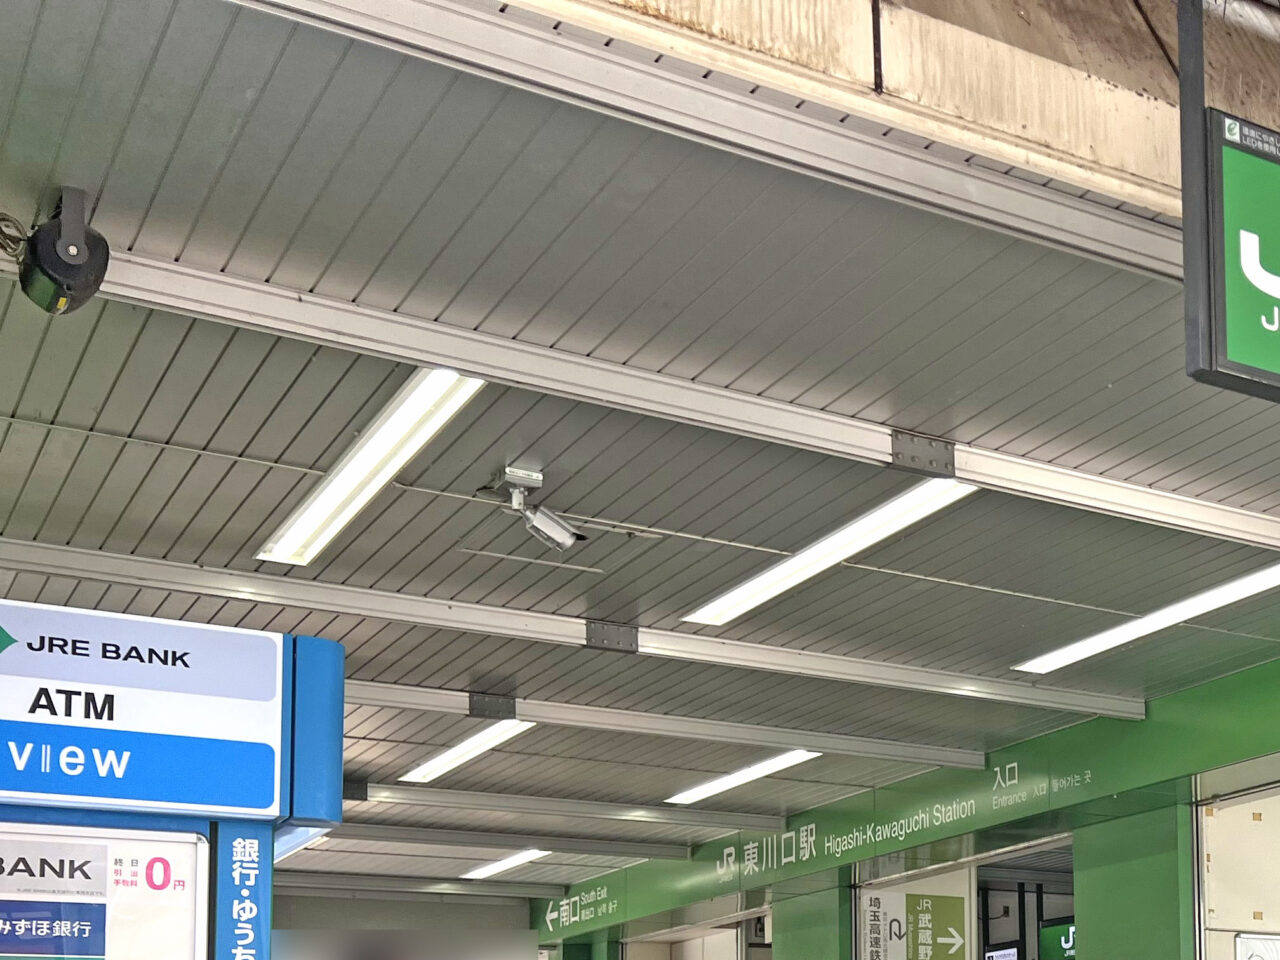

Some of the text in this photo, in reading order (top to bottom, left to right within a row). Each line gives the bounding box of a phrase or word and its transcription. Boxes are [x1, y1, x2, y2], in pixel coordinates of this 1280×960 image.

[27, 635, 191, 668] JRE BANK
[28, 687, 115, 721] ATM
[993, 762, 1018, 791] 入口
[993, 791, 1027, 810] Entrance
[1033, 783, 1047, 798] 入口
[744, 799, 976, 876] 東川口駅 Higashi-Kawaguchi Station
[0, 857, 92, 880] ANK
[716, 847, 736, 874] JR
[559, 896, 580, 928] 南口
